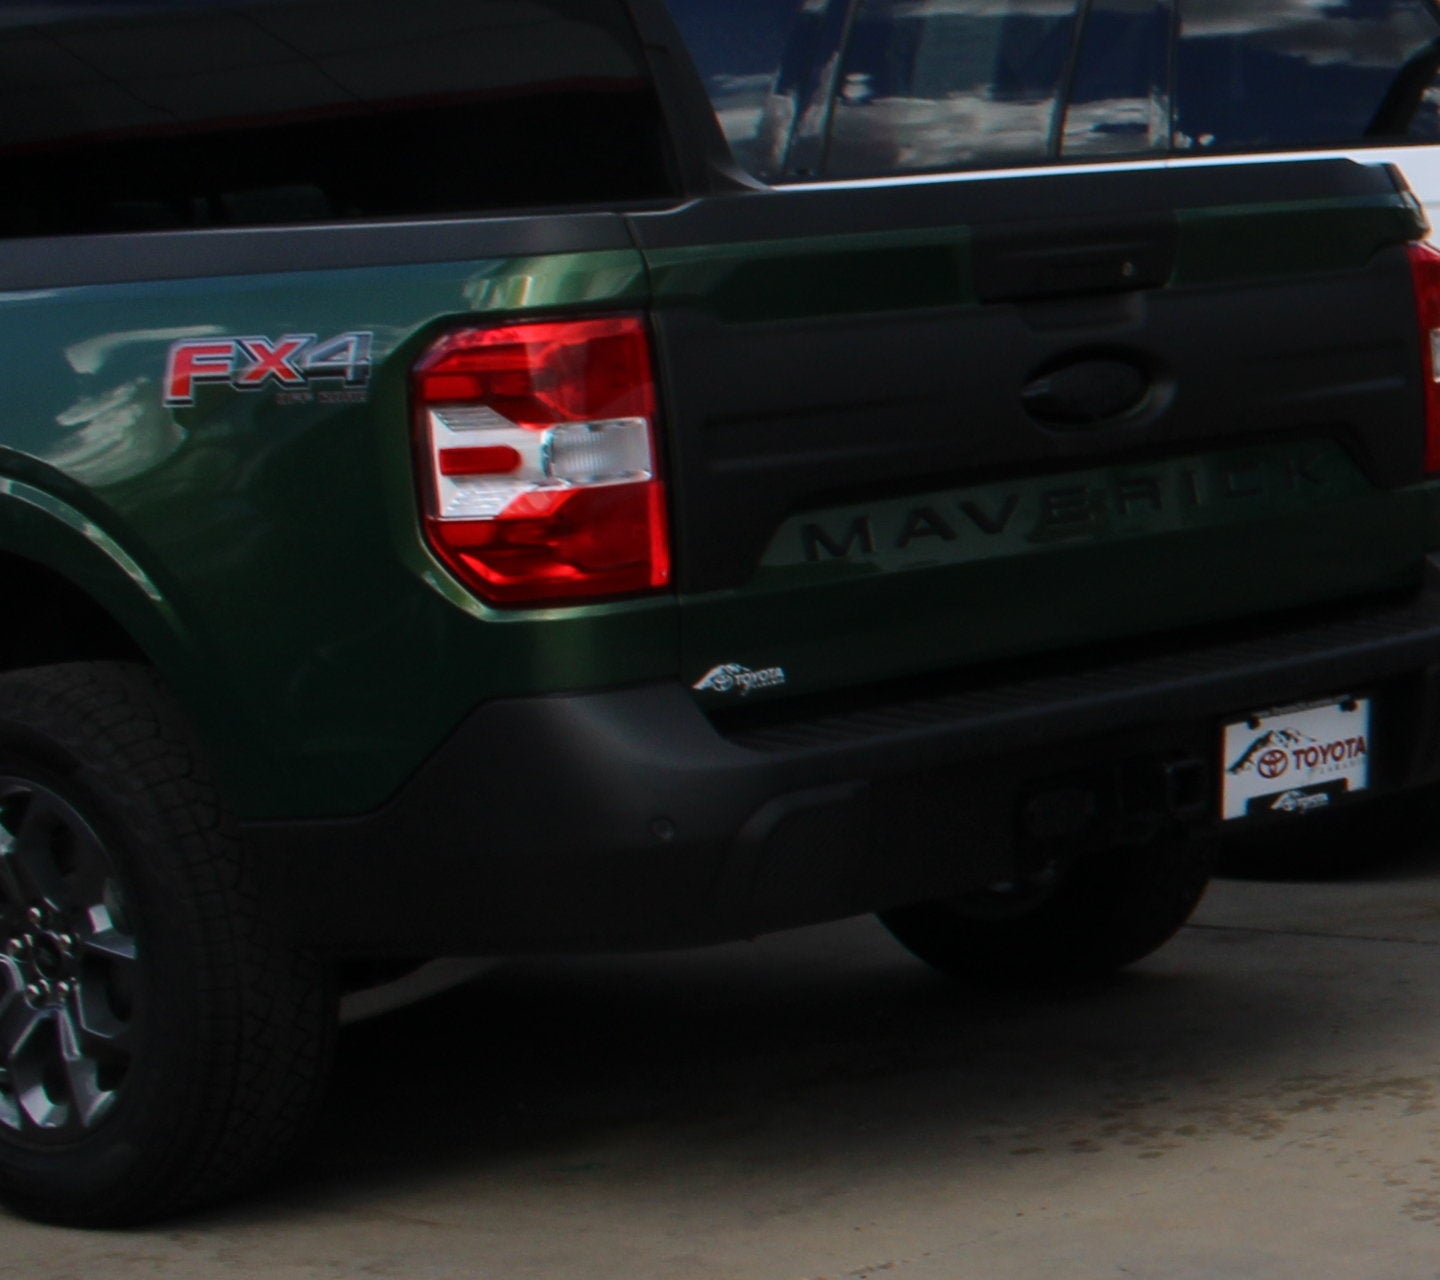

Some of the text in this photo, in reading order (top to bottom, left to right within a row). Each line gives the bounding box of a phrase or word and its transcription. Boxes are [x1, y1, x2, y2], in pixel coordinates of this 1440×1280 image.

[162, 331, 373, 408] FX4
[805, 454, 1330, 562] MAVERICK
[1292, 736, 1368, 770] TOYOTA
